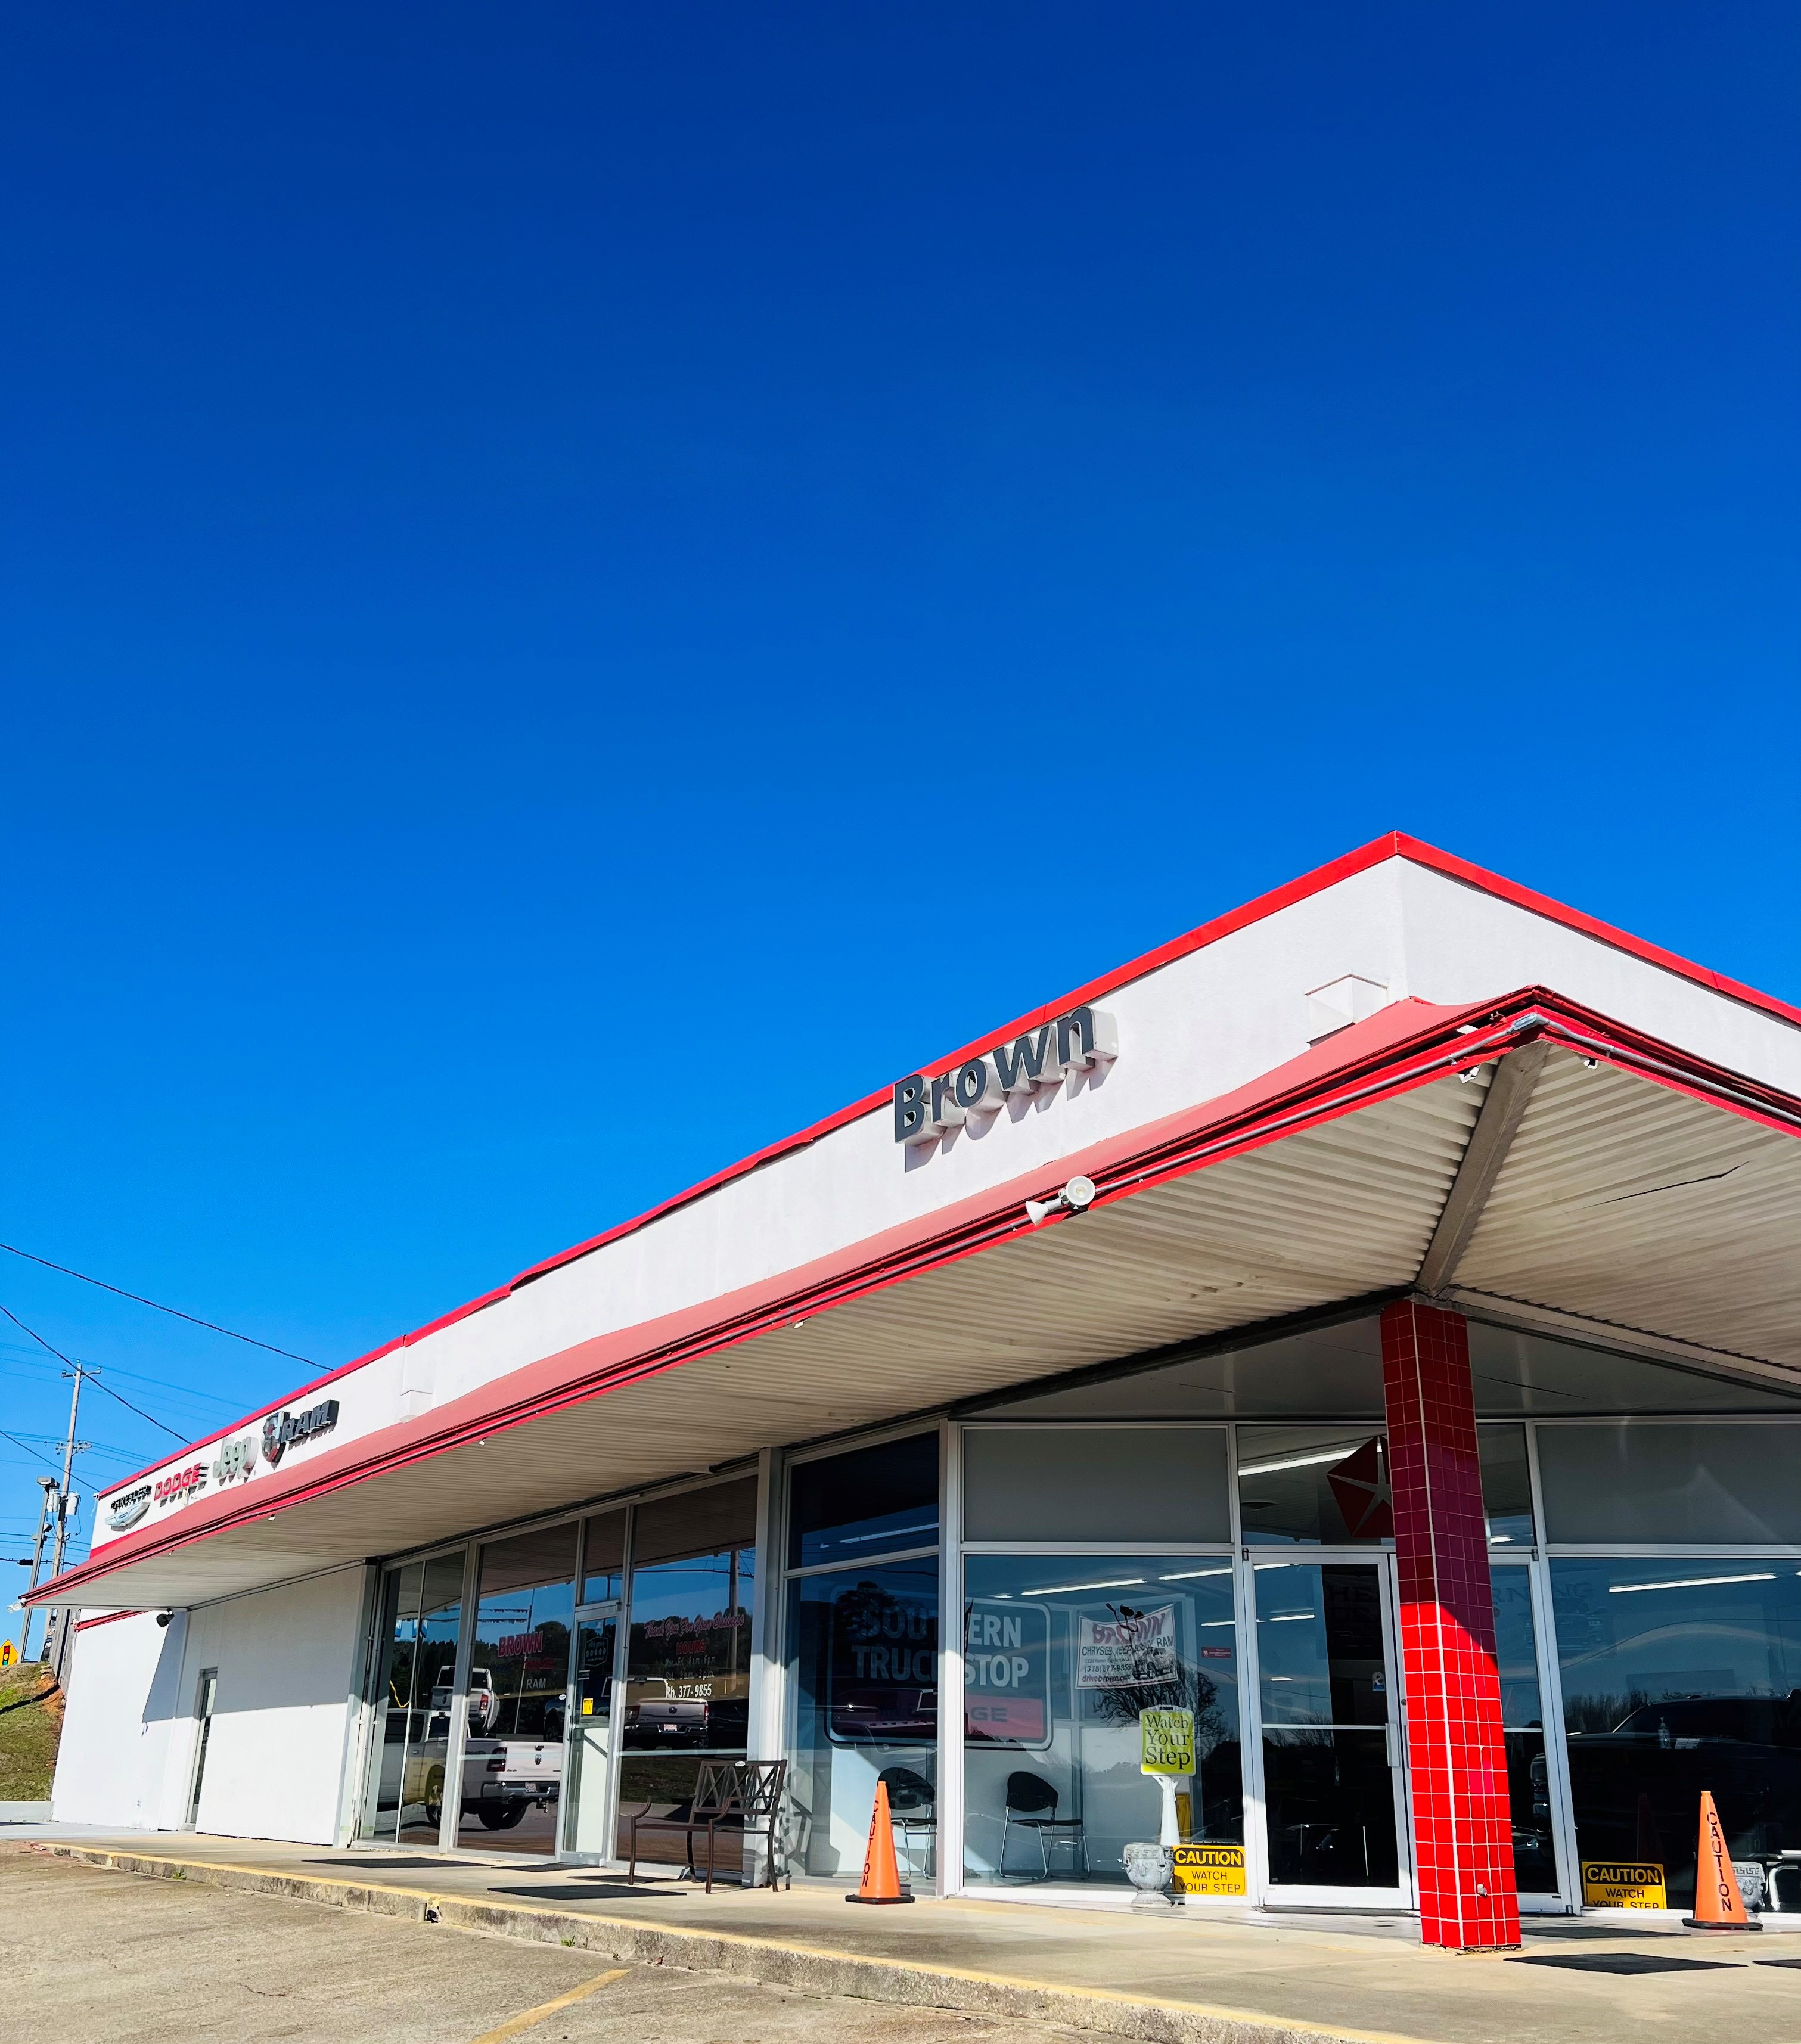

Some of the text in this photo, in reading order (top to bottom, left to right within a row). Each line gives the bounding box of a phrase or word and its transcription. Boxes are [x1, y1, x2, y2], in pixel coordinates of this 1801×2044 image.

[894, 1006, 1098, 1144] Brown
[281, 1400, 334, 1443] RAM
[213, 1436, 253, 1479] Jeep
[154, 1463, 201, 1501] DODGE
[644, 1611, 745, 1641] Thank You For Your Business
[497, 1630, 544, 1658] BROWN
[676, 1639, 706, 1655] HOURS
[1082, 1645, 1113, 1656] CHRYSLER
[526, 1678, 546, 1689] RAM
[678, 1683, 712, 1698] 377-9855
[1145, 1714, 1188, 1729] Watch
[1145, 1729, 1189, 1746] Your
[1145, 1746, 1190, 1770] Step
[862, 1800, 879, 1887] CAUTION
[1175, 1850, 1241, 1865] CAUTION
[1707, 1812, 1732, 1912] CAUTION
[1191, 1871, 1228, 1880] WATCH
[1587, 1868, 1659, 1883] CAUTION
[1179, 1883, 1241, 1893] YOUR STEP
[1605, 1888, 1644, 1898] WATCH
